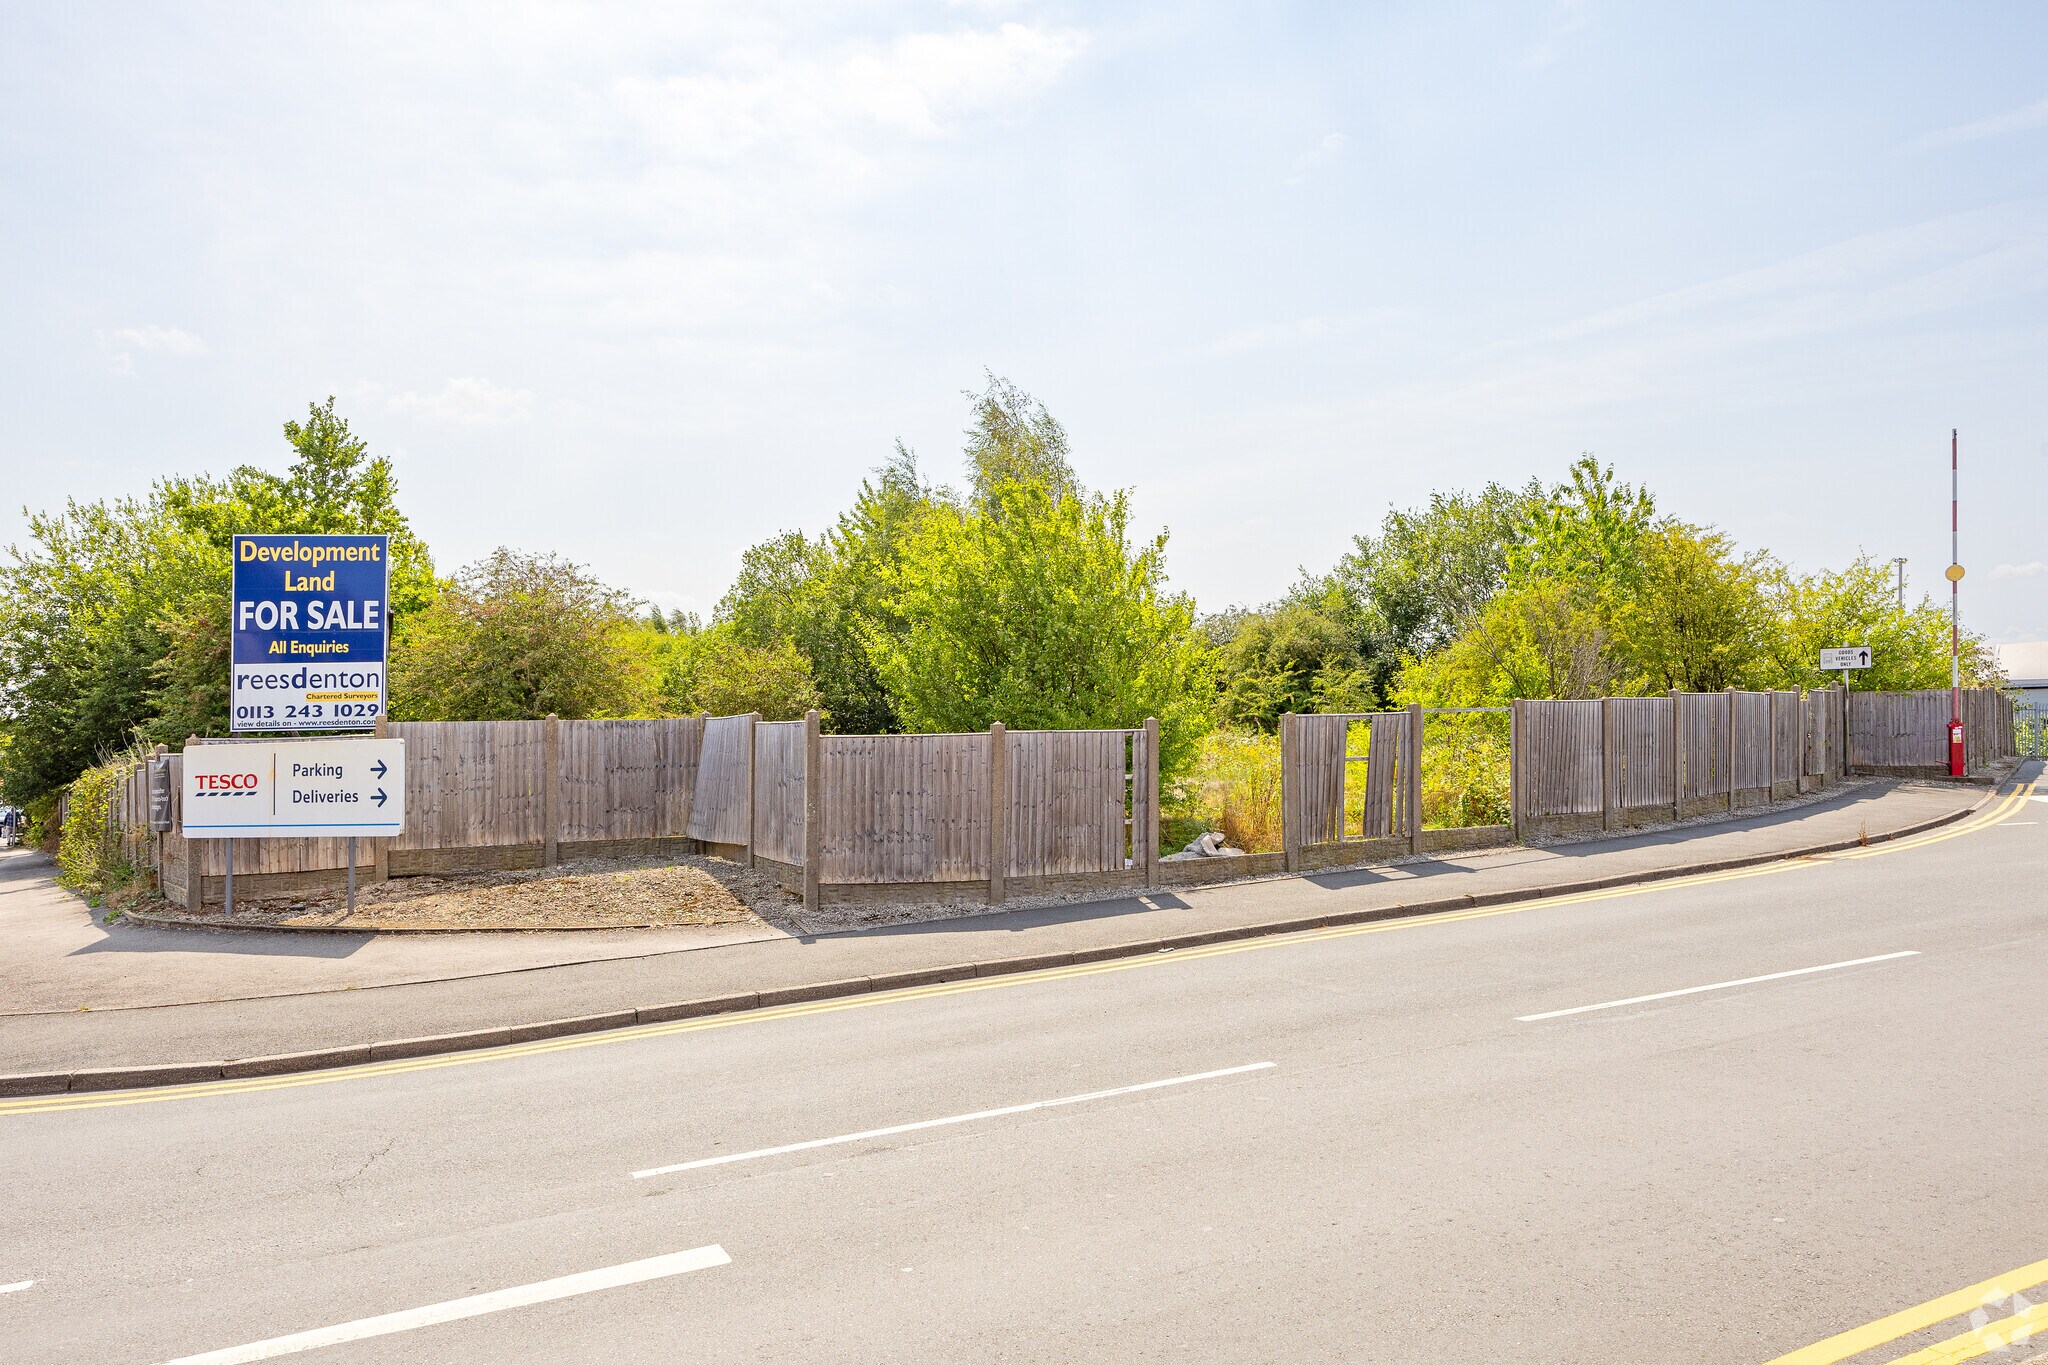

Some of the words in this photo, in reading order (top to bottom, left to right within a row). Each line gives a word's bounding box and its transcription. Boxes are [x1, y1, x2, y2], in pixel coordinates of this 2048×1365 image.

[240, 541, 381, 568] Development
[284, 570, 335, 592] Land
[239, 601, 299, 631] FOR
[307, 600, 379, 630] SALE
[269, 640, 286, 654] All
[290, 640, 349, 657] Enquiries
[237, 667, 379, 690] reesdenton
[344, 693, 378, 701] Surveyors
[236, 705, 274, 719] 0113
[285, 704, 323, 718] 243
[334, 703, 379, 717] 1029
[292, 762, 343, 780] Parking
[195, 773, 258, 790] TESCO
[292, 789, 359, 804] Deliveries
